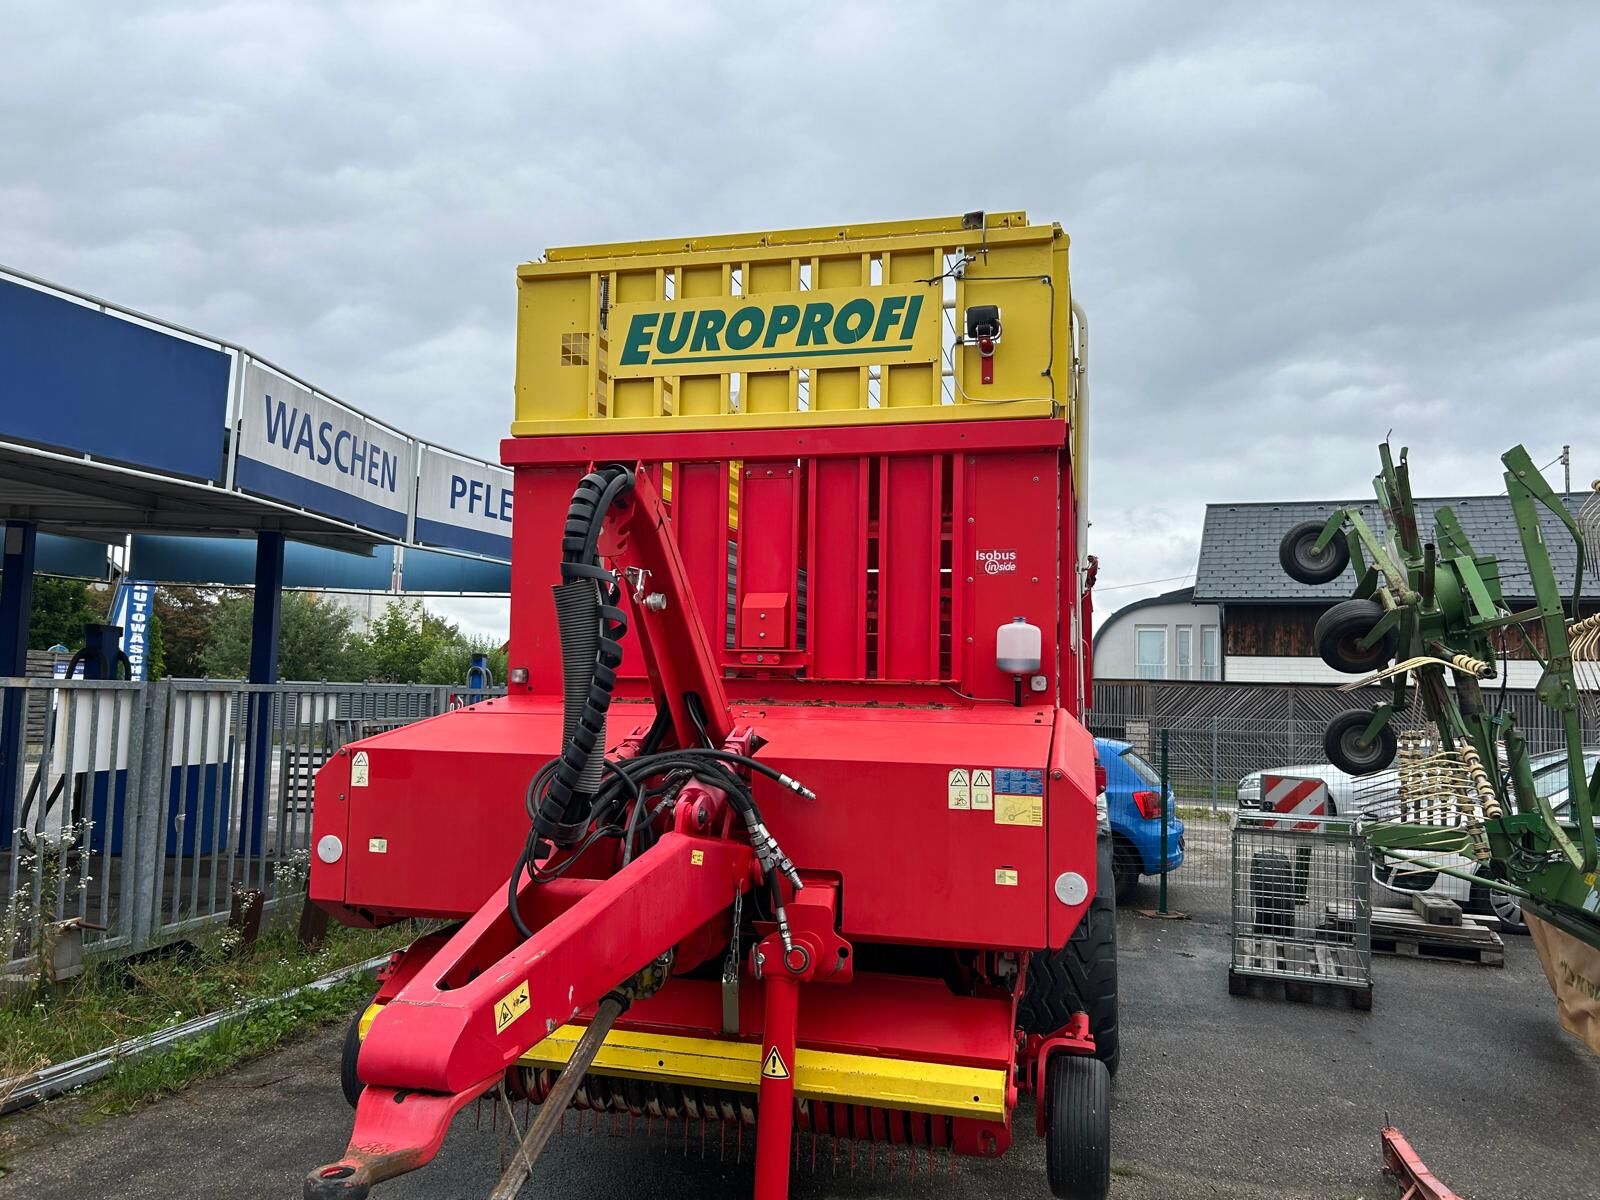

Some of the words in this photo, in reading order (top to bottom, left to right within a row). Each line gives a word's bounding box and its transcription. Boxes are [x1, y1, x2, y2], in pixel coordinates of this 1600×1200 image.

[620, 296, 925, 366] EUROPROFI
[265, 394, 398, 493] WASCHEN
[450, 474, 513, 522] PFLE
[976, 550, 1016, 560] Isobus
